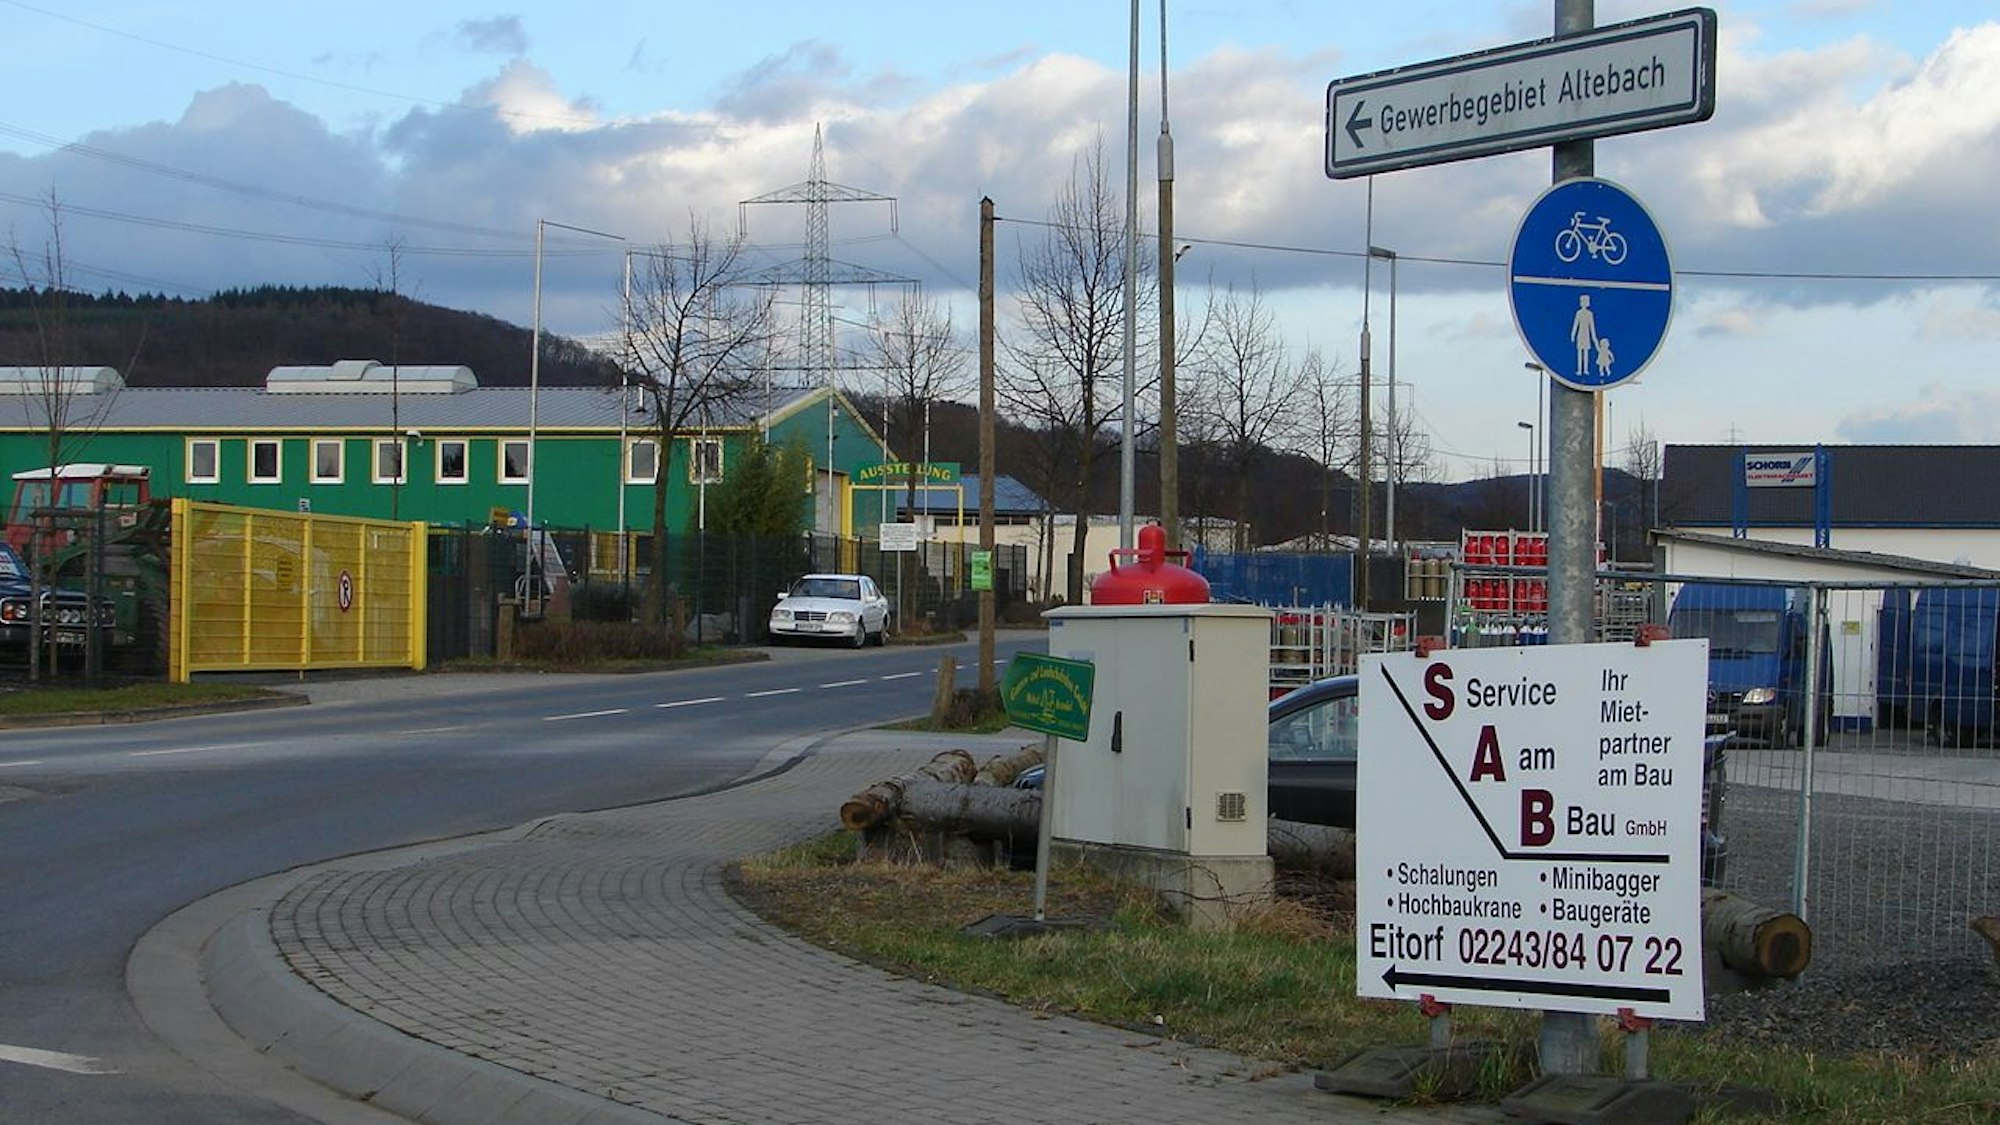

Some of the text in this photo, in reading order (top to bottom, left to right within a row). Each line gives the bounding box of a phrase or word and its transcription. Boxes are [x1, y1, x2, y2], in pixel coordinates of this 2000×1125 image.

[1381, 56, 1664, 133] Gewerbegebiet Altebach
[860, 463, 951, 480] AUSSTELUNG
[1424, 663, 1556, 720] S Service
[1602, 669, 1628, 691] Ihr
[1601, 700, 1648, 722] Miet-
[1469, 725, 1554, 782] A am
[1600, 733, 1671, 760] partner
[1599, 764, 1672, 786] am Bau
[1521, 789, 1666, 846] B Bau GmbH
[1399, 863, 1497, 891] Schalungen
[1553, 868, 1660, 897] Minibagger
[1399, 893, 1521, 919] Hochbaukrane
[1553, 898, 1650, 927] Baugeräte
[1371, 923, 1682, 975] Eitorf 02243/84 07 22
